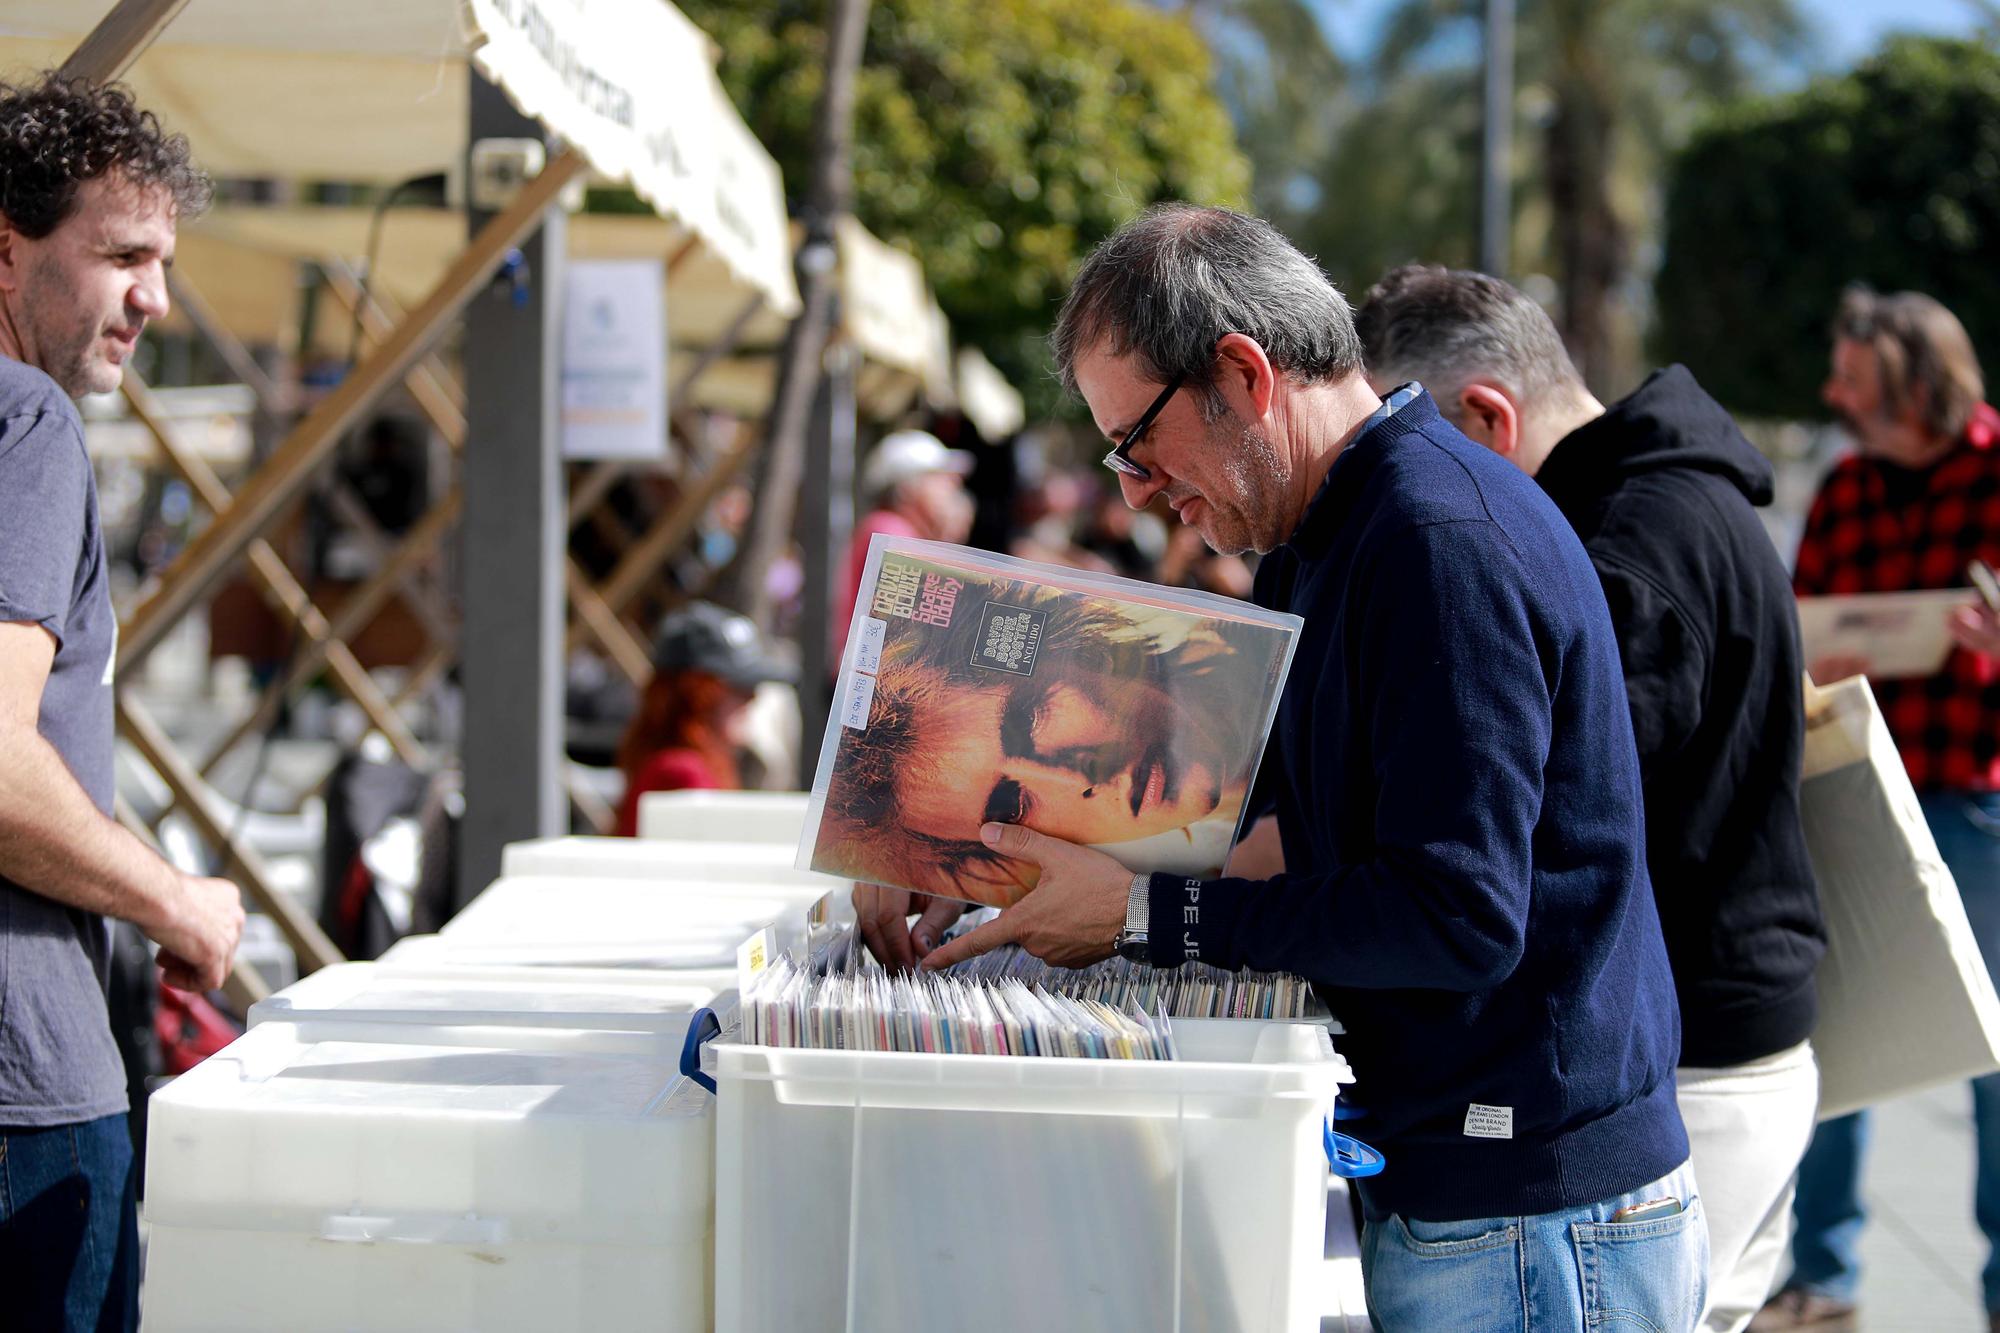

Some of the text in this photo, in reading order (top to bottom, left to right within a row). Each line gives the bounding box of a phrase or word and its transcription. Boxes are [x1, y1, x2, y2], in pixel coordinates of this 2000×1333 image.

[873, 561, 922, 619] DAVID BOWIE
[983, 615, 1004, 658] DAVID
[996, 616, 1018, 663] BOWIE
[1006, 612, 1032, 670] POSTER
[1023, 623, 1040, 664] INCLUIDO
[1486, 1118, 1507, 1127] BRAND
